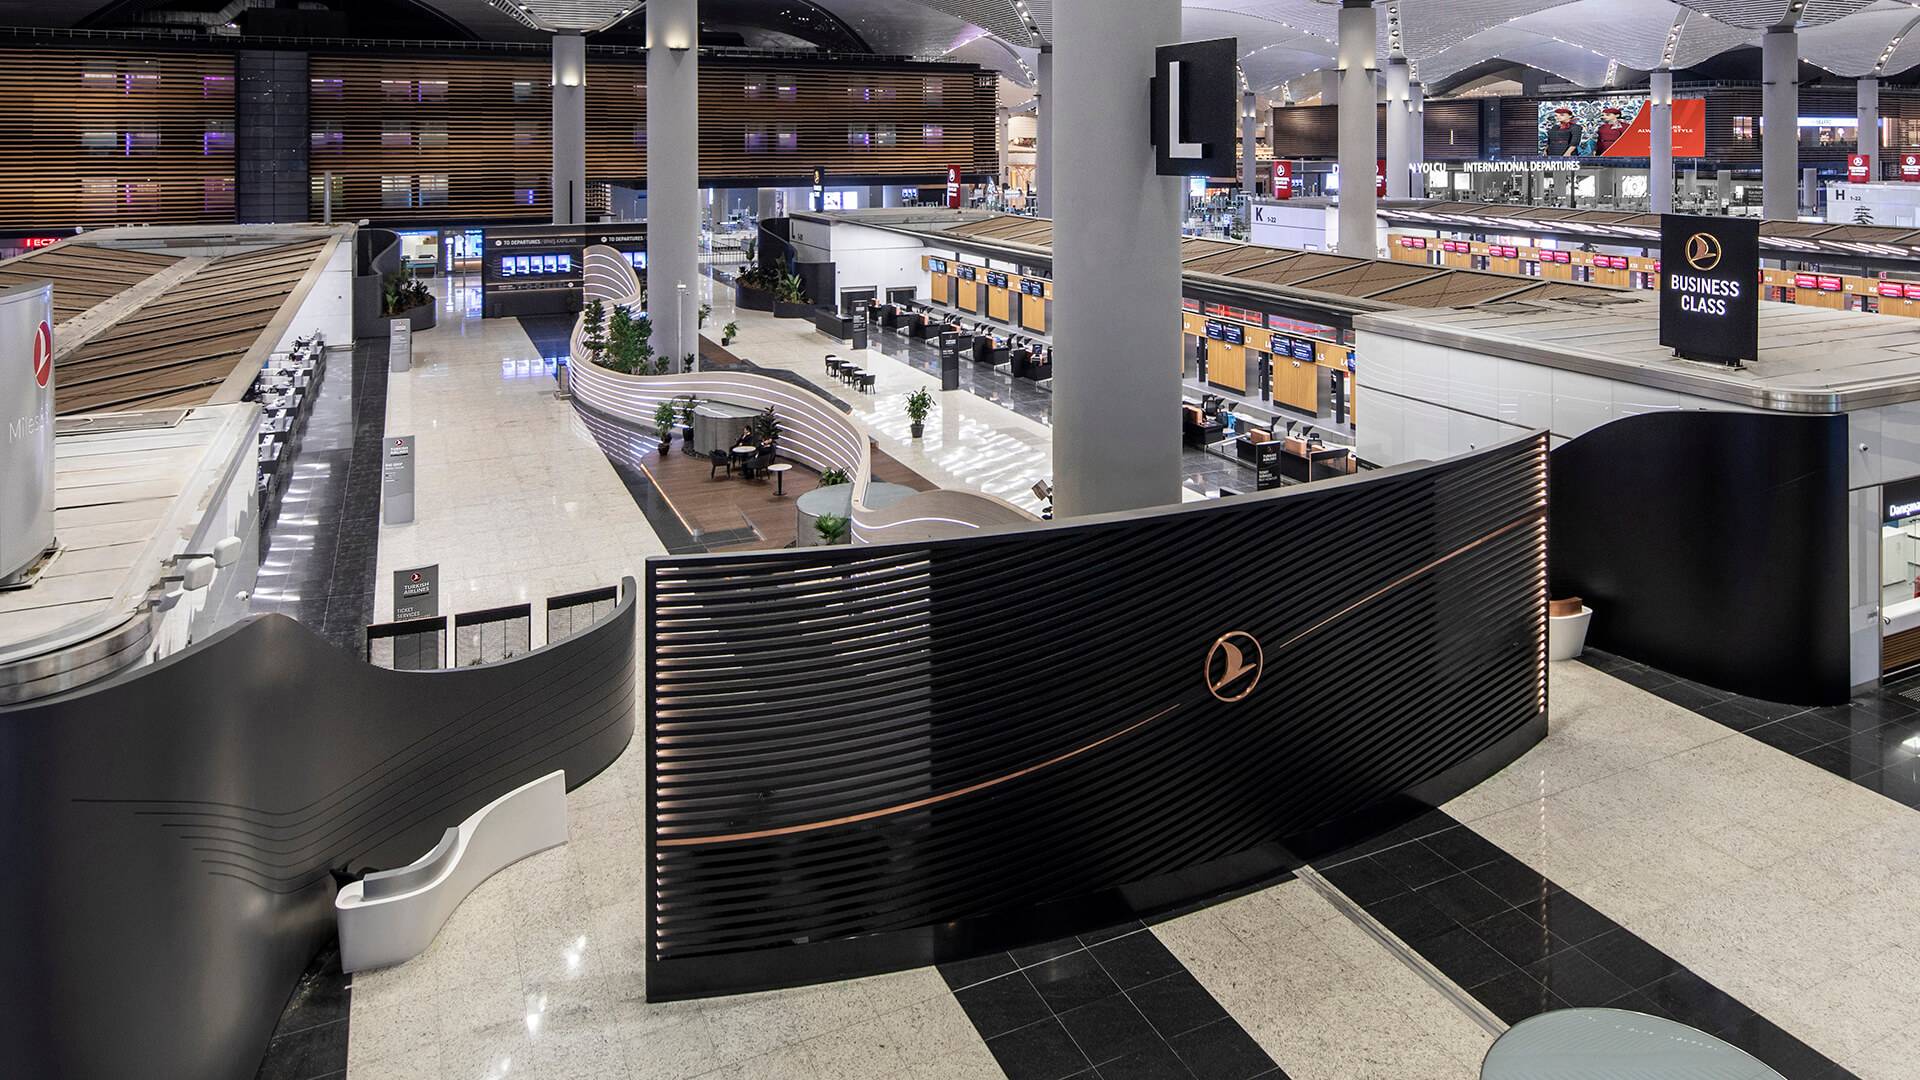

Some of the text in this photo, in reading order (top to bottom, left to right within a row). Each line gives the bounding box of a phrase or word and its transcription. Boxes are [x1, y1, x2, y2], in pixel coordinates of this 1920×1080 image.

[1169, 61, 1202, 158] L
[1464, 161, 1529, 172] INTERNATIONAL
[1530, 161, 1580, 172] DEPARTURES
[1835, 190, 1845, 200] H
[1256, 207, 1263, 221] K
[1671, 274, 1740, 297] BUSINESS
[1681, 295, 1726, 315] CLASS
[403, 581, 430, 590] TURKISH
[403, 586, 430, 595] AIRLINES
